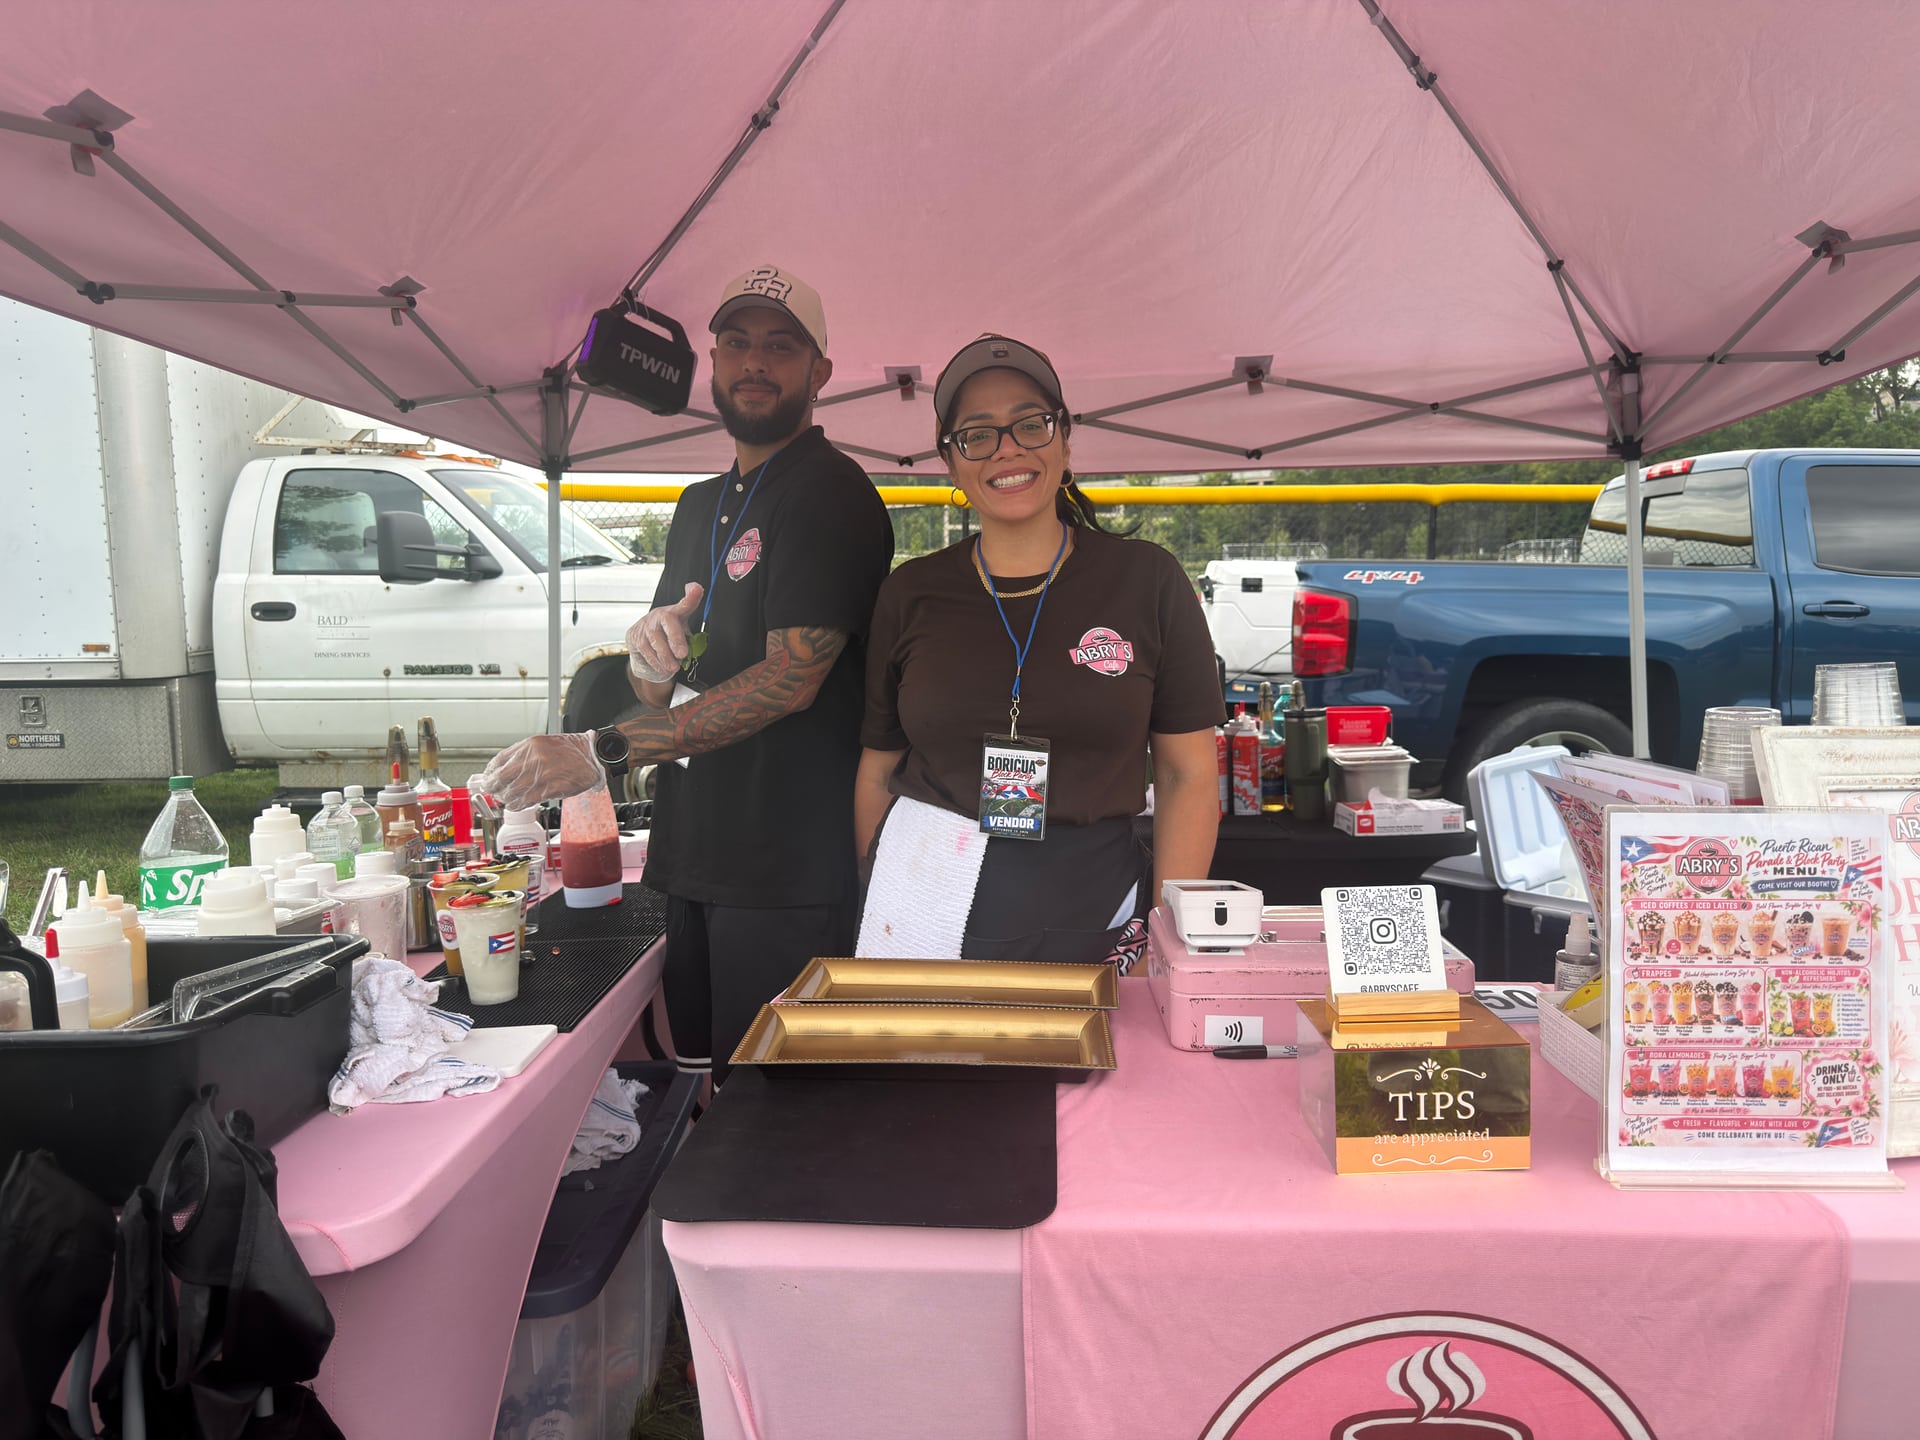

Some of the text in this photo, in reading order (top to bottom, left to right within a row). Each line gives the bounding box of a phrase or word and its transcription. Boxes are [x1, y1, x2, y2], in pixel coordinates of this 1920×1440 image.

[744, 267, 793, 304] PR
[620, 342, 681, 384] TPWiN
[1344, 570, 1425, 584] 4x4
[1076, 642, 1132, 663] ABRY'S
[18, 735, 60, 743] NORTHERN
[987, 756, 1036, 774] BORICUA
[991, 768, 1035, 782] Block Party
[988, 816, 1035, 829] VENDOR
[1759, 838, 1833, 855] Puerto Rican
[1678, 857, 1740, 874] ABRY'S
[1746, 851, 1849, 873] Parade & Block Party
[1773, 867, 1817, 876] MENU
[1757, 882, 1775, 890] COME
[1776, 881, 1792, 889] VISIT
[1807, 880, 1829, 888] BOOTH!
[1641, 970, 1673, 978] FRAPPES
[1816, 1063, 1850, 1076] DRINKS
[1822, 1074, 1847, 1085] ONLY
[1388, 1090, 1477, 1123] TIPS
[1373, 1127, 1491, 1147] are appreciated
